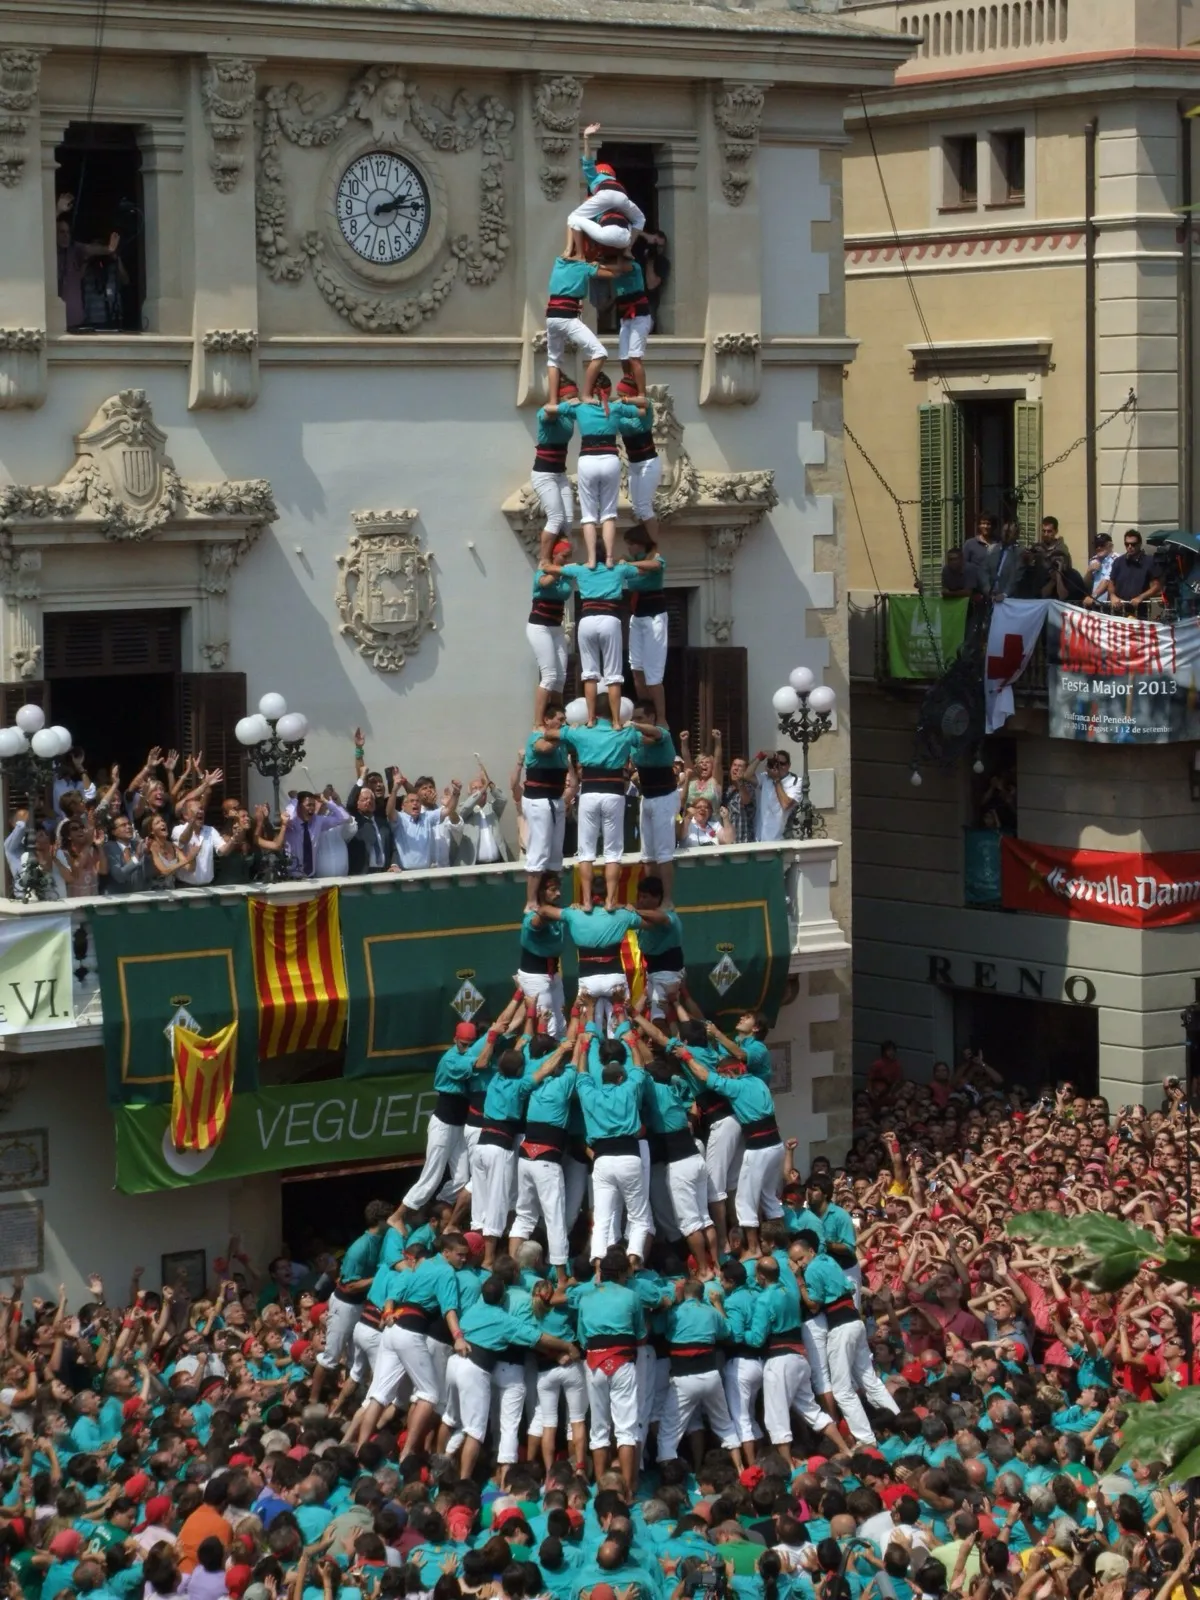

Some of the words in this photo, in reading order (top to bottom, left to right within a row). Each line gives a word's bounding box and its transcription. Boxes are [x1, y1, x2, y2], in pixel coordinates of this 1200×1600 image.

[360, 165, 368, 182] 11
[376, 160, 386, 177] 12
[395, 166, 399, 182] 1
[348, 179, 359, 195] 10
[406, 180, 412, 197] 2
[345, 199, 353, 215] 9
[350, 219, 357, 235] 8
[405, 221, 411, 237] 4
[364, 235, 371, 251] 7
[378, 239, 386, 255] 6
[395, 235, 402, 252] 5
[1061, 677, 1089, 693] Festa
[1093, 680, 1133, 698] Major
[1138, 680, 1177, 695] 2013
[1091, 714, 1102, 723] del
[1103, 715, 1136, 724] Penedès
[1047, 867, 1134, 907] Estrella
[926, 954, 1097, 1006] RENO
